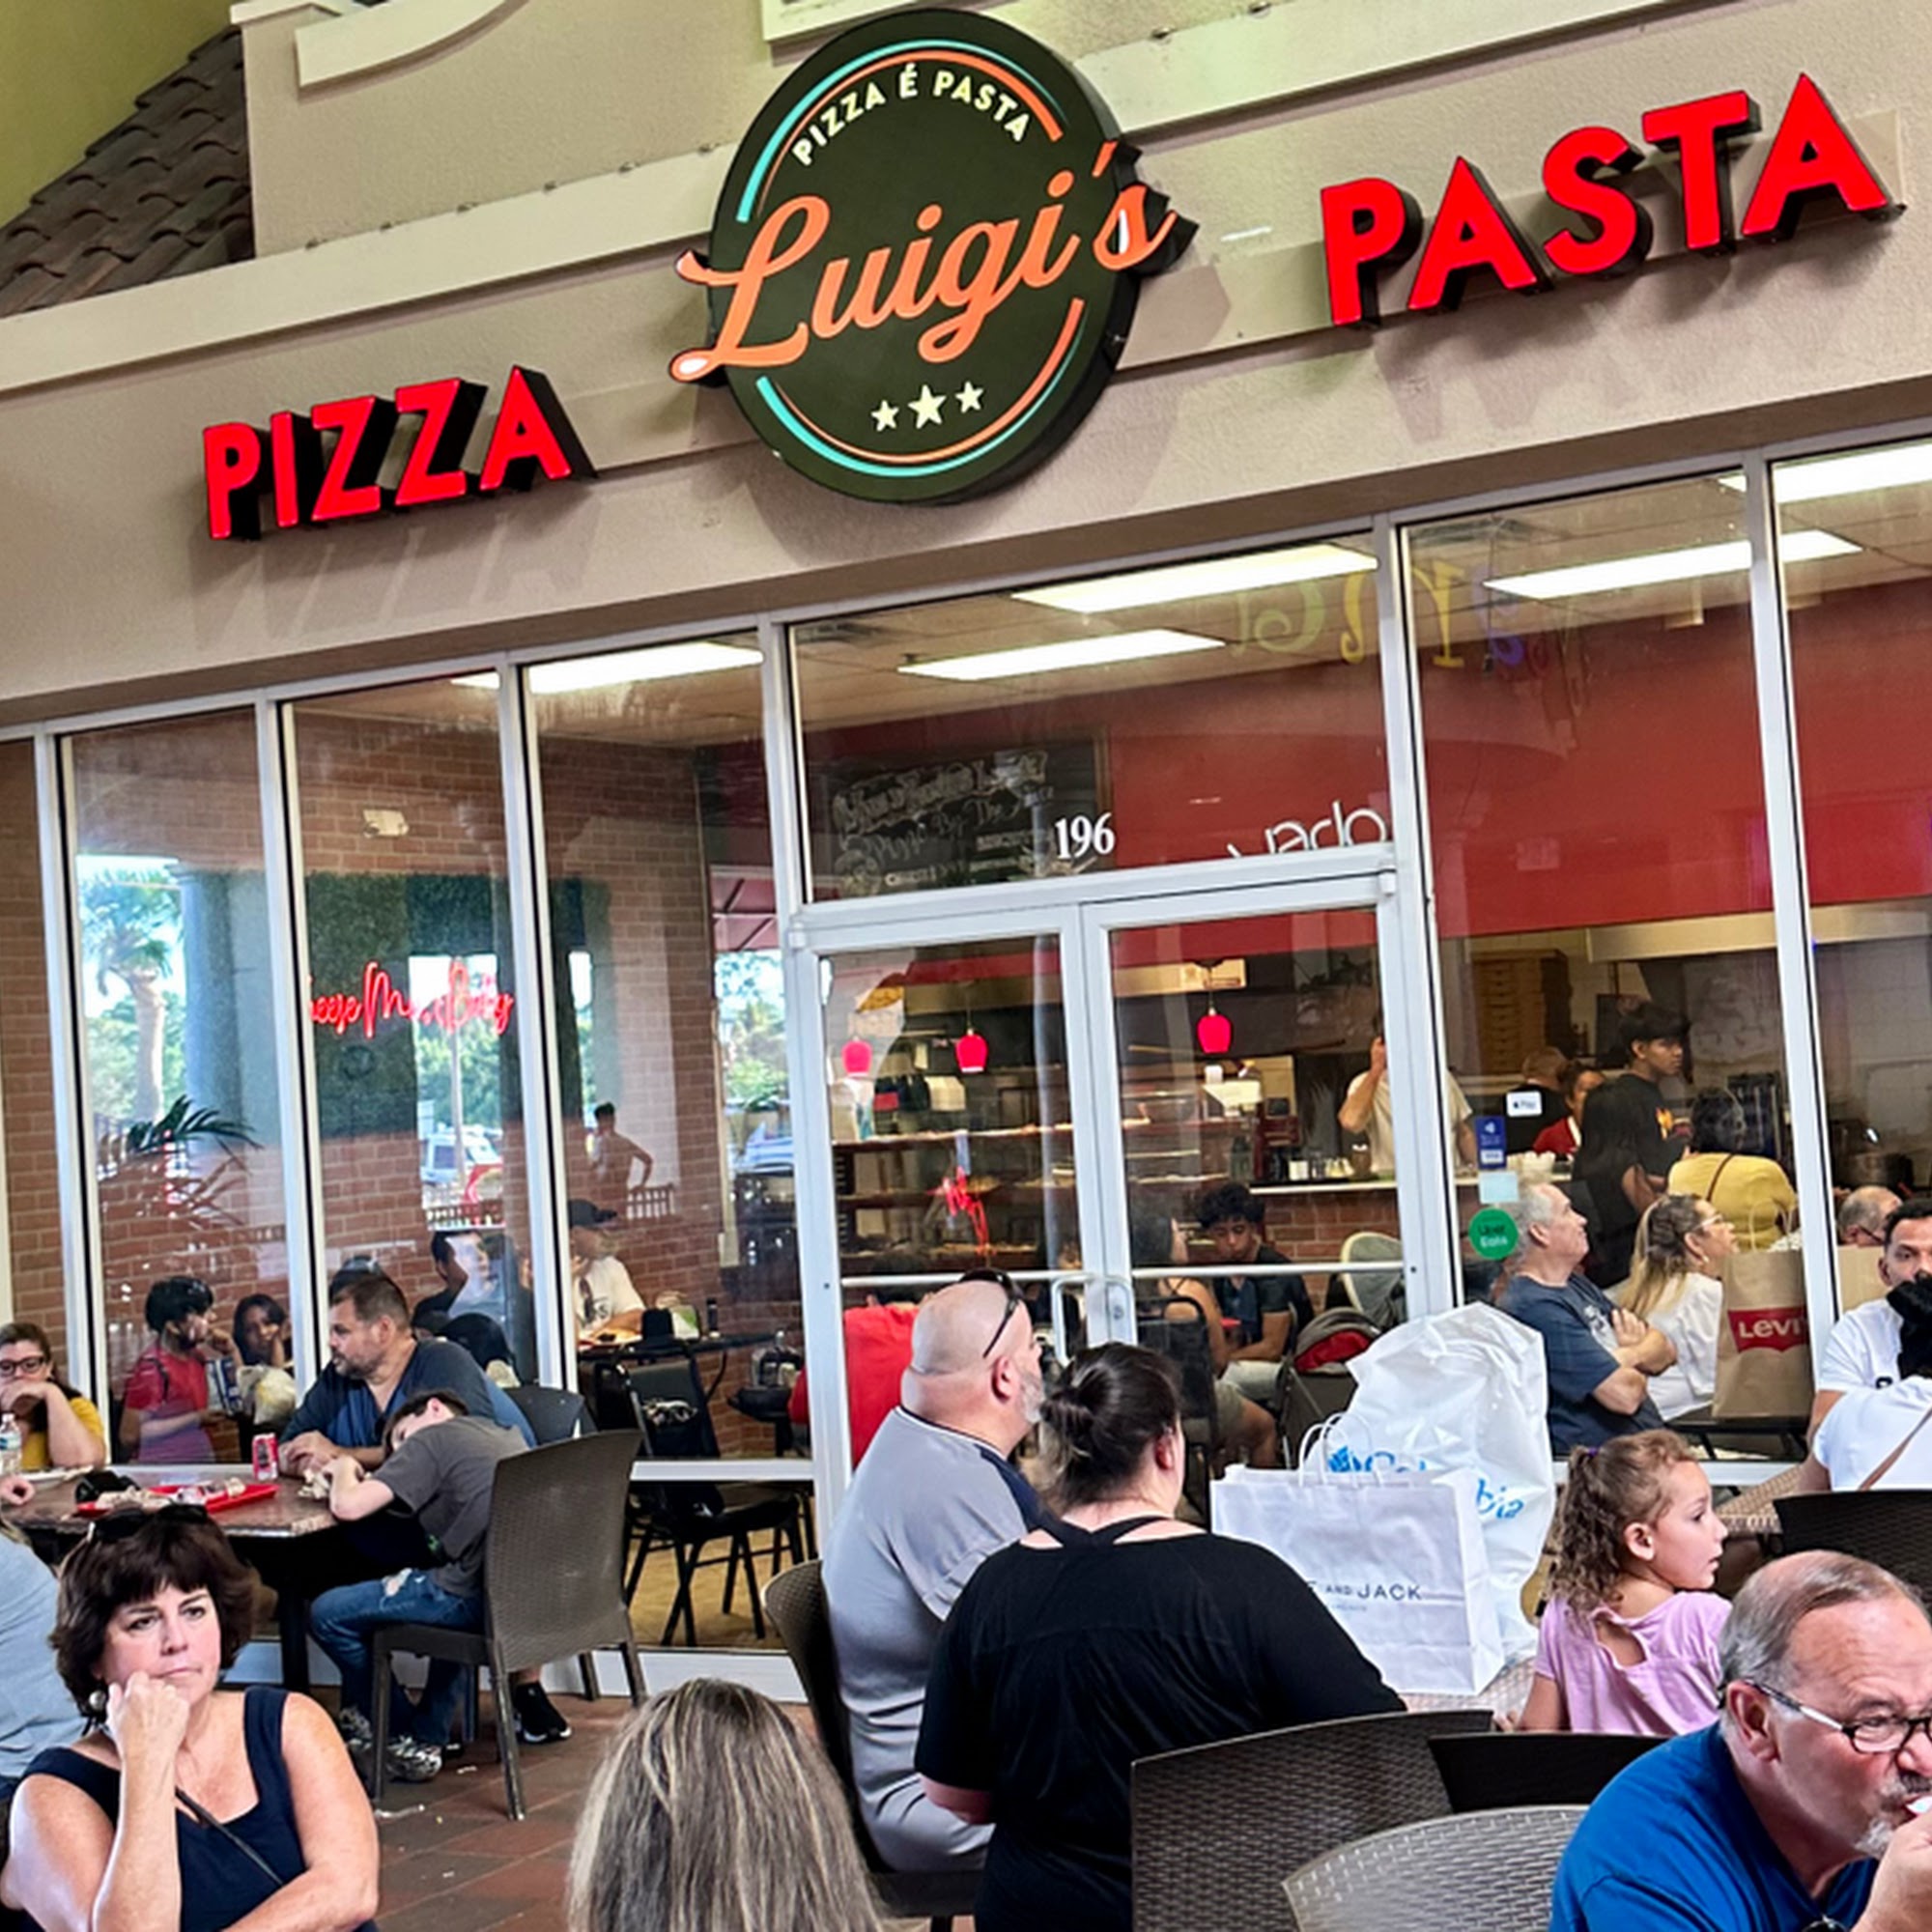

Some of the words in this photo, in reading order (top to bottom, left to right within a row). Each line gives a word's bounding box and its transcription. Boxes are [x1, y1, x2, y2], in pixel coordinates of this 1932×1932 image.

[792, 82, 886, 166] PIZZA
[899, 62, 918, 99] É
[933, 71, 1030, 142] PASTA
[203, 364, 573, 540] PIZZA
[1321, 72, 1889, 327] PASTA
[668, 140, 1179, 383] Luigi's
[1054, 811, 1116, 860] 196
[1356, 1583, 1422, 1602] JACK
